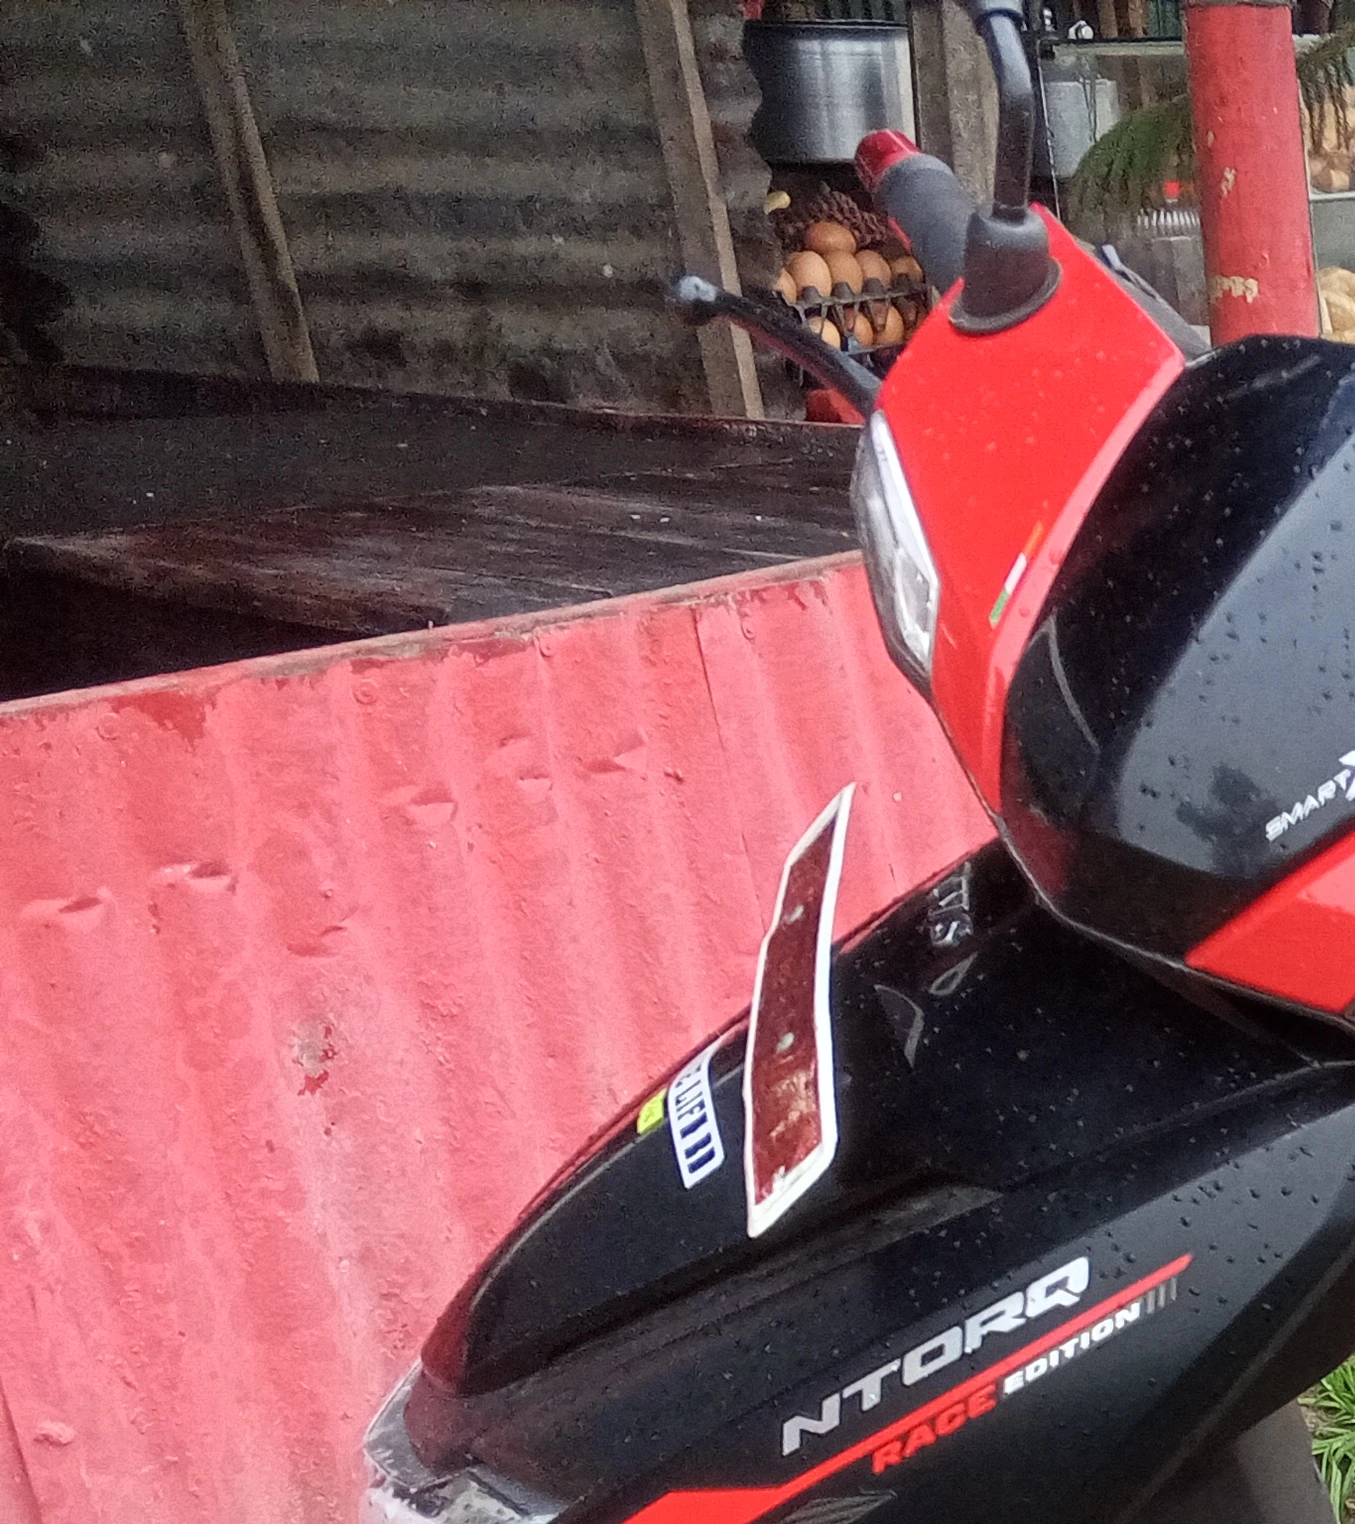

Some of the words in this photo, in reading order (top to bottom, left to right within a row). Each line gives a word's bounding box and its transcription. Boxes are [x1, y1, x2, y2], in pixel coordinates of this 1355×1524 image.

[782, 1256, 1092, 1456] NTORQ
[872, 1384, 997, 1475] RACE
[1003, 1302, 1141, 1397] EDITION
